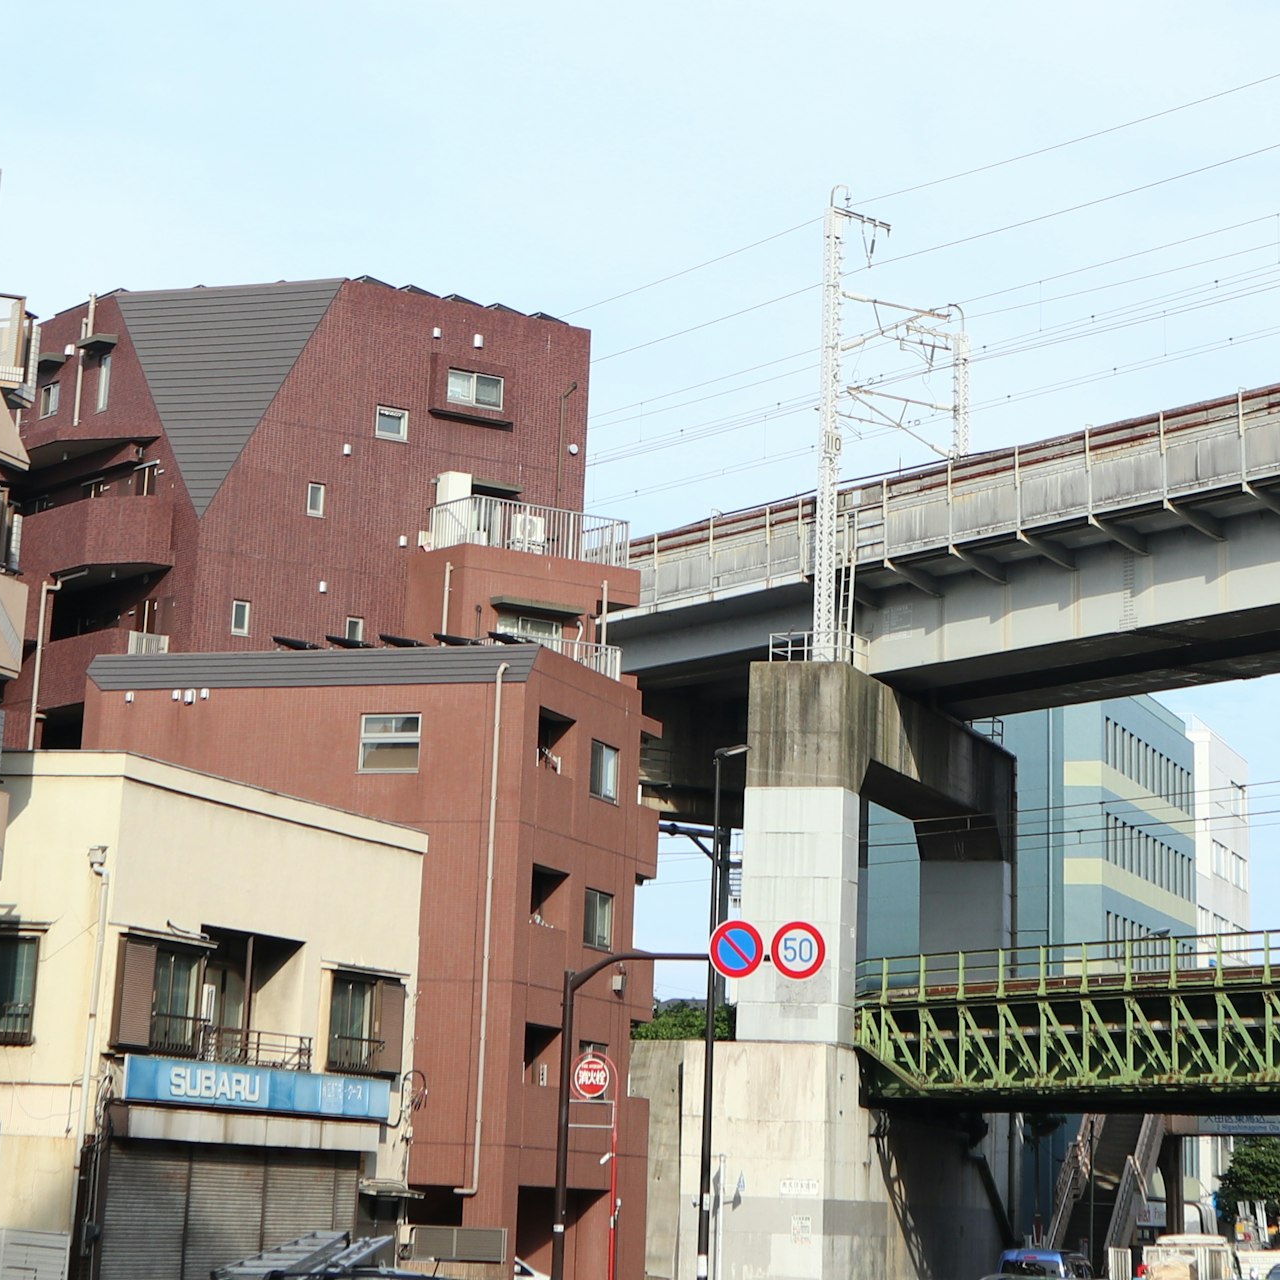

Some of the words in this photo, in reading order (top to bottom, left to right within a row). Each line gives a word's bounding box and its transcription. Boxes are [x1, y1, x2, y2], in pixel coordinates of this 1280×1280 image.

[782, 936, 814, 963] 50
[169, 1066, 261, 1102] SUBARU
[578, 1069, 606, 1085] 消火栓
